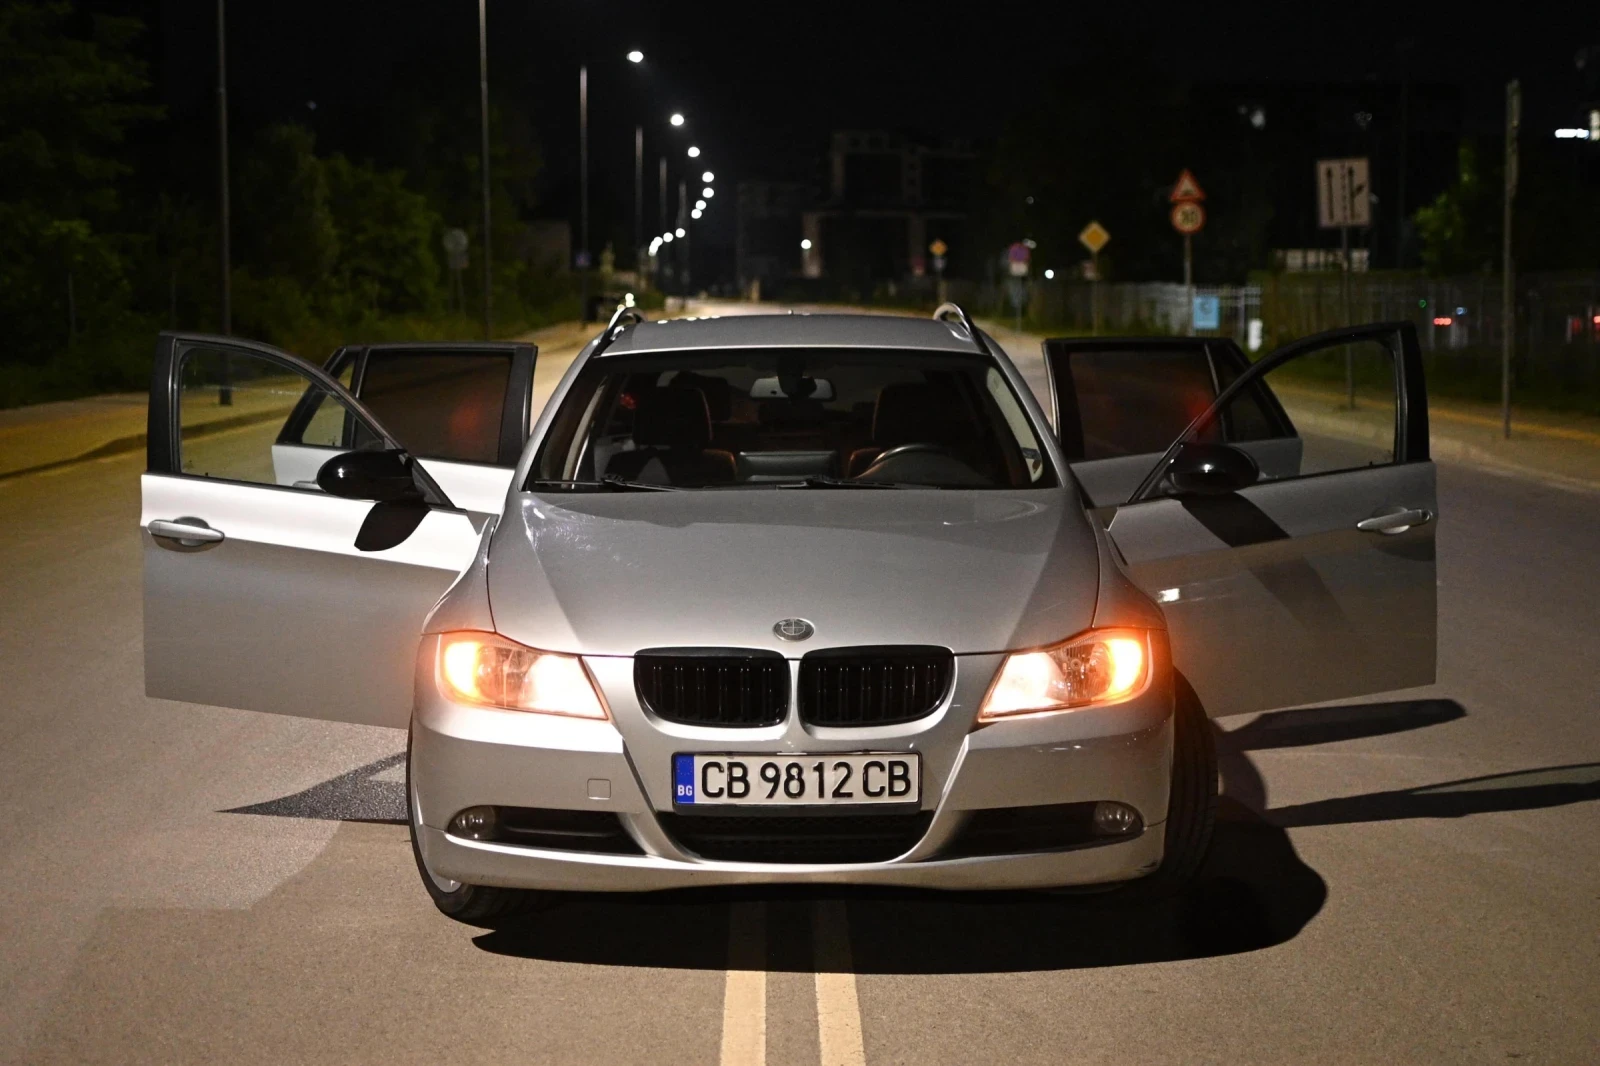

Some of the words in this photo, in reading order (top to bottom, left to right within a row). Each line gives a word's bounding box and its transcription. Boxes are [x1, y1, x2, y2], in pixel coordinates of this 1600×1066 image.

[677, 784, 693, 796] BG
[701, 761, 750, 798] CB
[760, 761, 854, 798] 9812
[862, 760, 911, 797] CB
